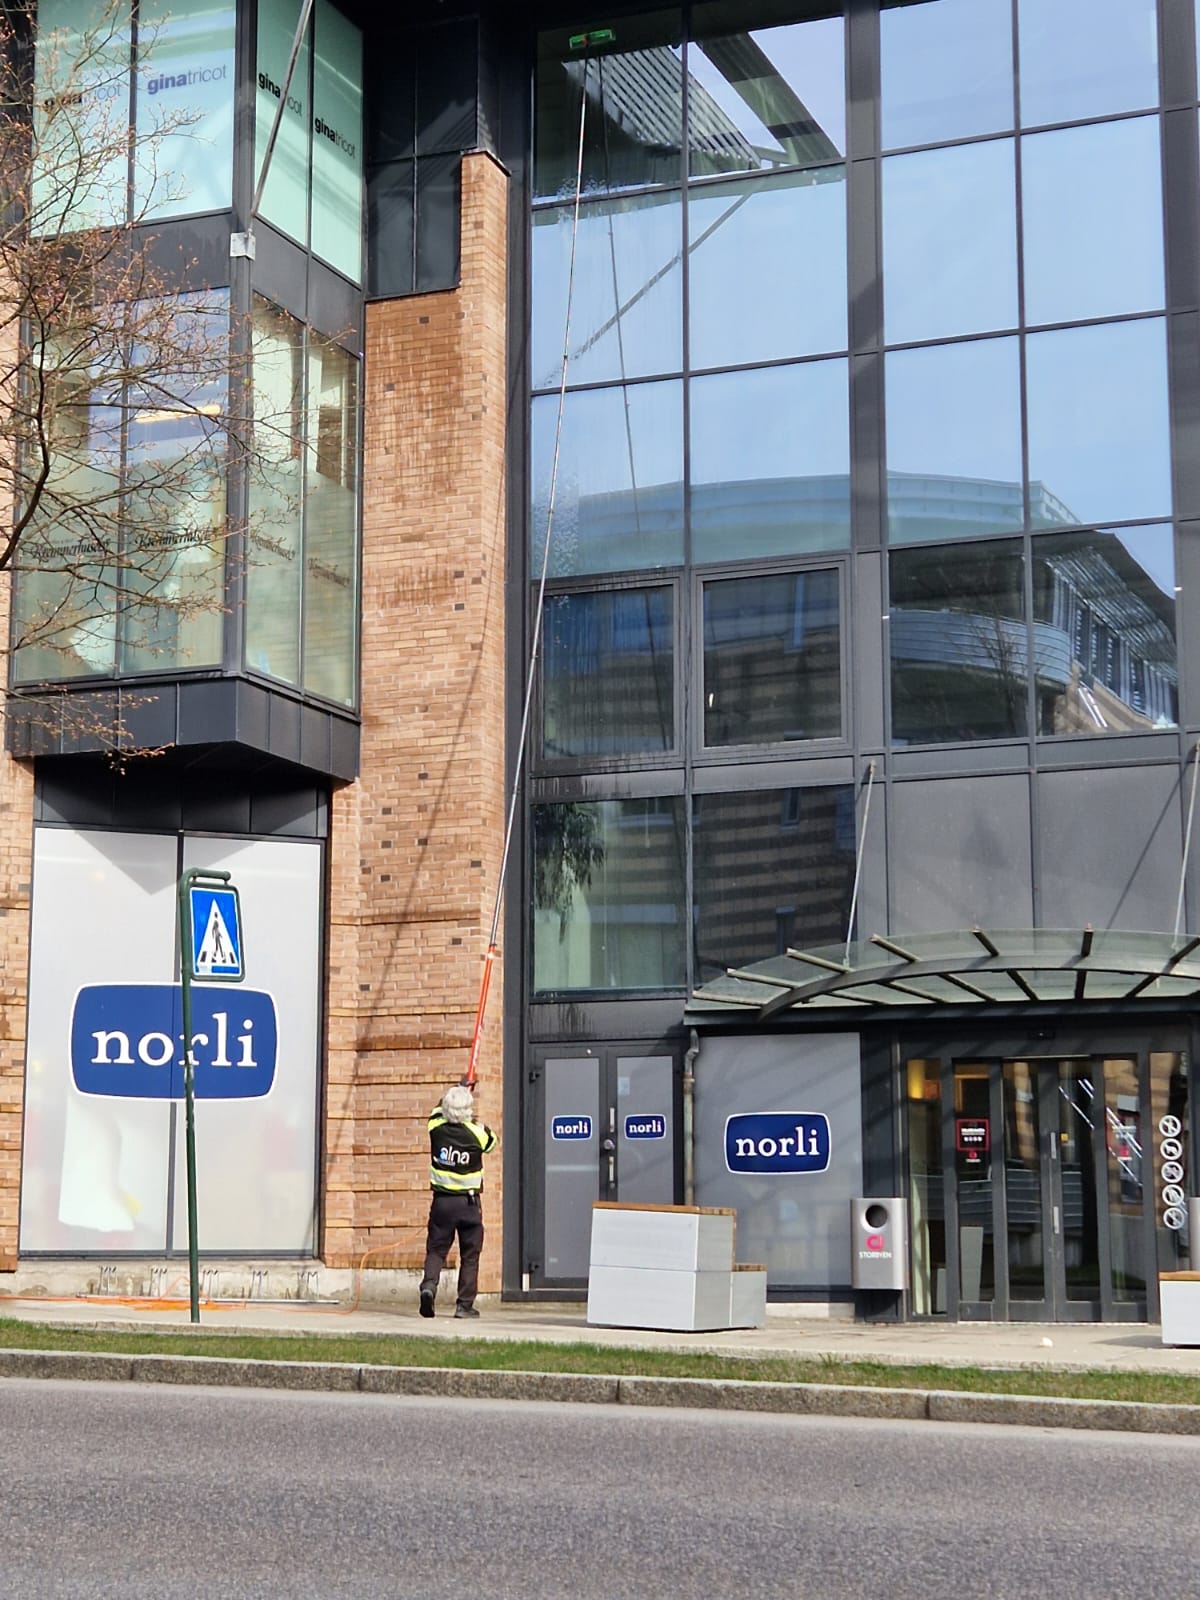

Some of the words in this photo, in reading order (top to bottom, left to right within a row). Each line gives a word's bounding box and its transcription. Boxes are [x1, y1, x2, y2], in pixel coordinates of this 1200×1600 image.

[147, 64, 227, 95] ginatricot
[258, 72, 302, 117] ginaicot
[91, 1012, 257, 1066] norli
[555, 1121, 589, 1134] norli
[628, 1120, 662, 1133] norli
[735, 1126, 820, 1157] norli
